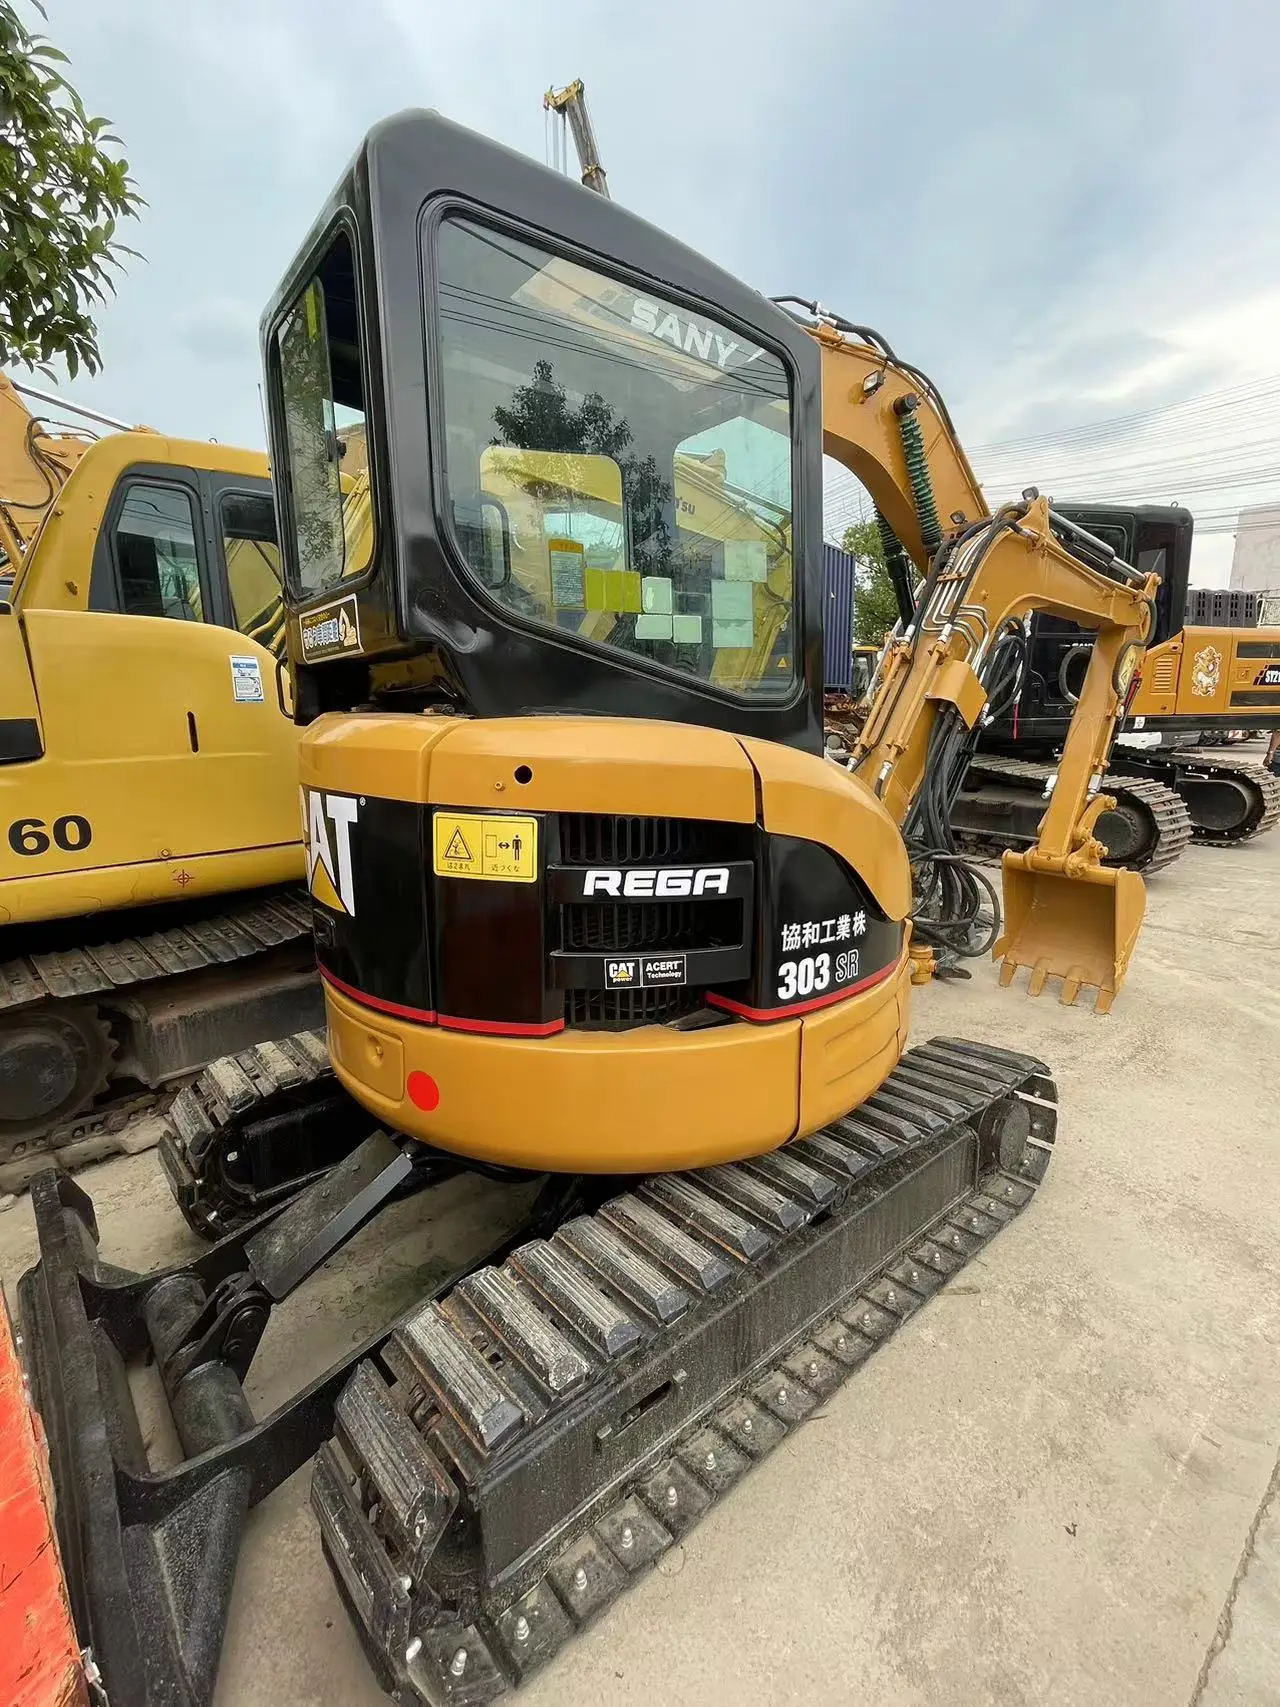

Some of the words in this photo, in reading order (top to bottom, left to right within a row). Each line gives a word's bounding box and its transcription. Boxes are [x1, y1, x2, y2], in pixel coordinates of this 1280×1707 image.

[629, 298, 740, 368] SANY
[7, 814, 93, 857] 60
[582, 867, 730, 897] REGA
[780, 909, 867, 952] 協和工業株
[608, 961, 636, 978] CAT
[612, 976, 633, 984] power
[645, 961, 680, 972] ACERT
[646, 970, 682, 980] Technology
[777, 952, 830, 1000] 303
[835, 948, 859, 983] SR
